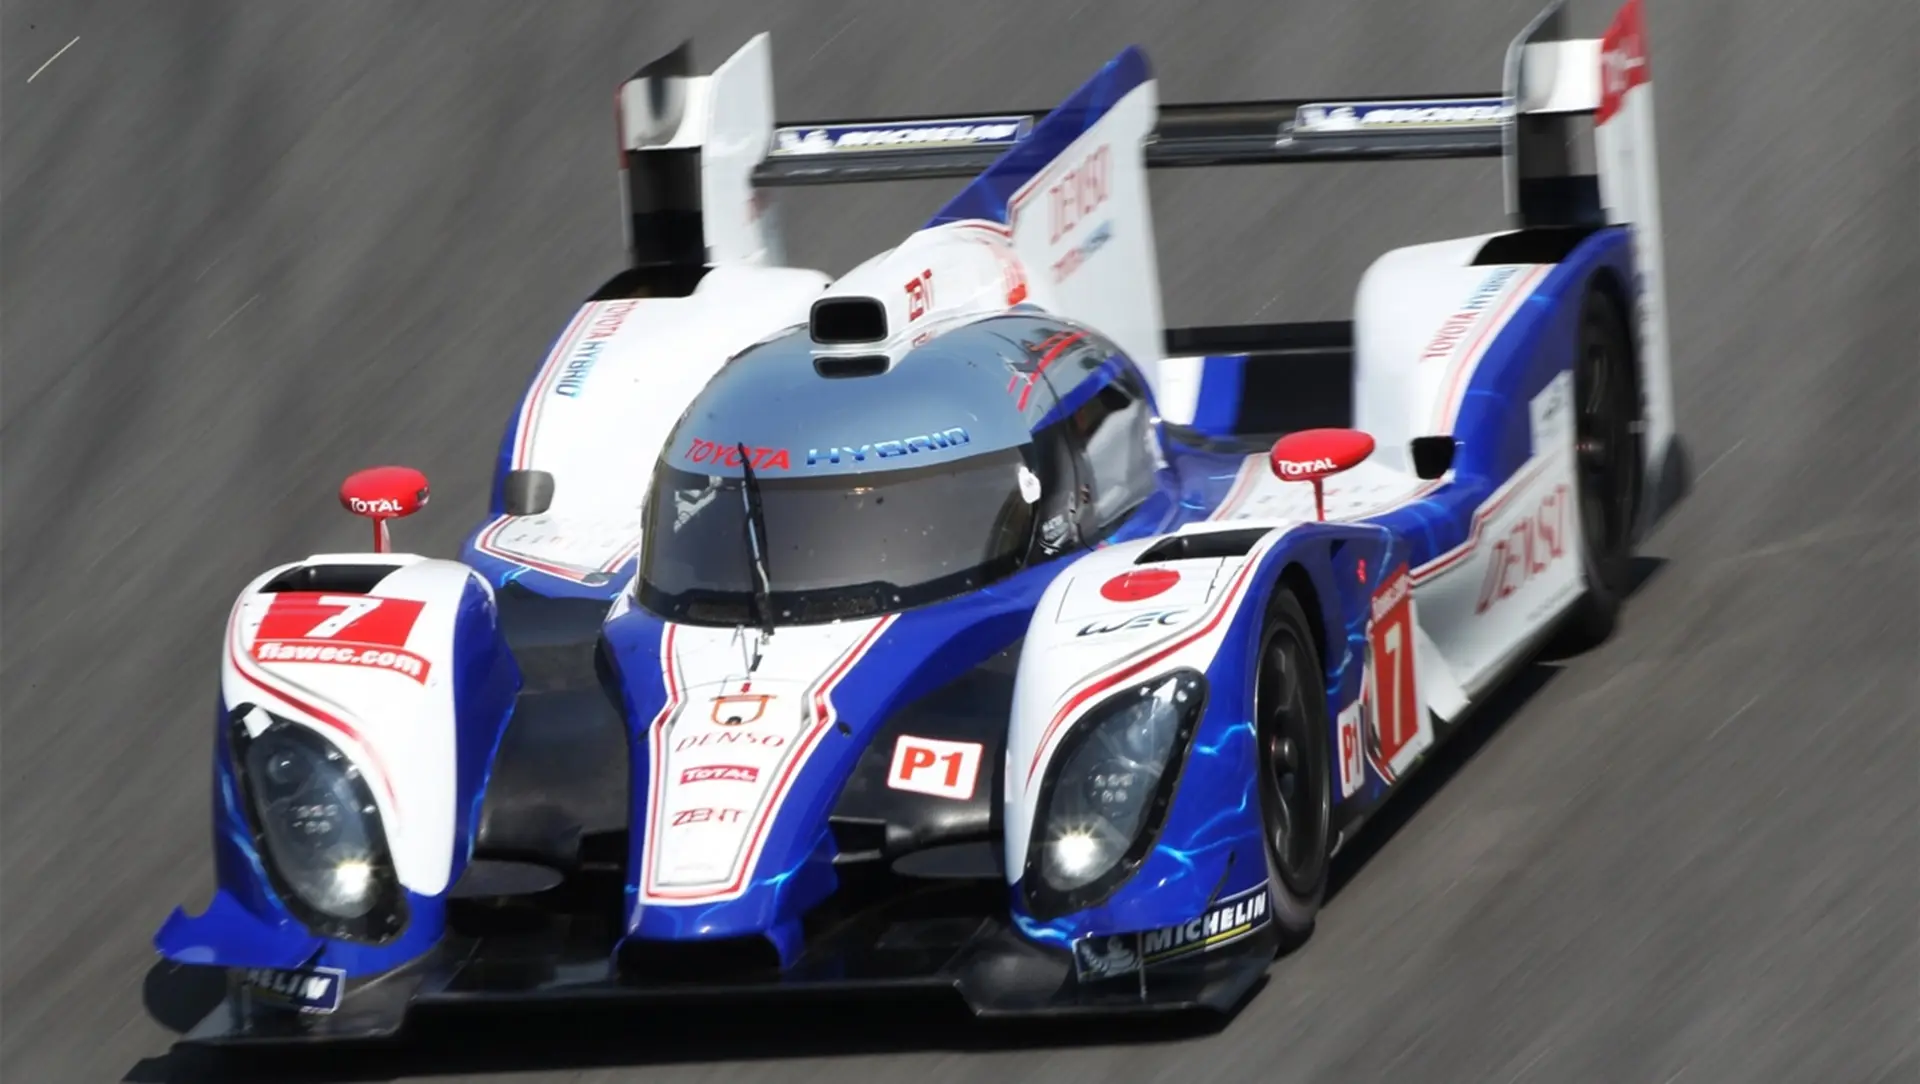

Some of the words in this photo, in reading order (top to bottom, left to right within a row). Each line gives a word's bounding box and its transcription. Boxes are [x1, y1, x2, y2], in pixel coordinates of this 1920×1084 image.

[1418, 311, 1481, 360] TOYOTA
[556, 340, 606, 397] HYBRID
[684, 437, 790, 471] TOYOTA
[807, 428, 971, 466] HYBRID
[1278, 457, 1337, 475] TOTAL
[350, 497, 403, 512] TOTAL
[304, 595, 384, 638] 7
[1076, 608, 1189, 637] WEC
[257, 642, 423, 676] fiawec.com
[1384, 621, 1402, 747] 7
[675, 732, 784, 752] DENSO
[1342, 720, 1361, 785] P1
[684, 769, 756, 782] TOTAL
[899, 746, 964, 787] P1
[672, 808, 744, 827] ZENT
[1146, 892, 1267, 953] MICHELIN
